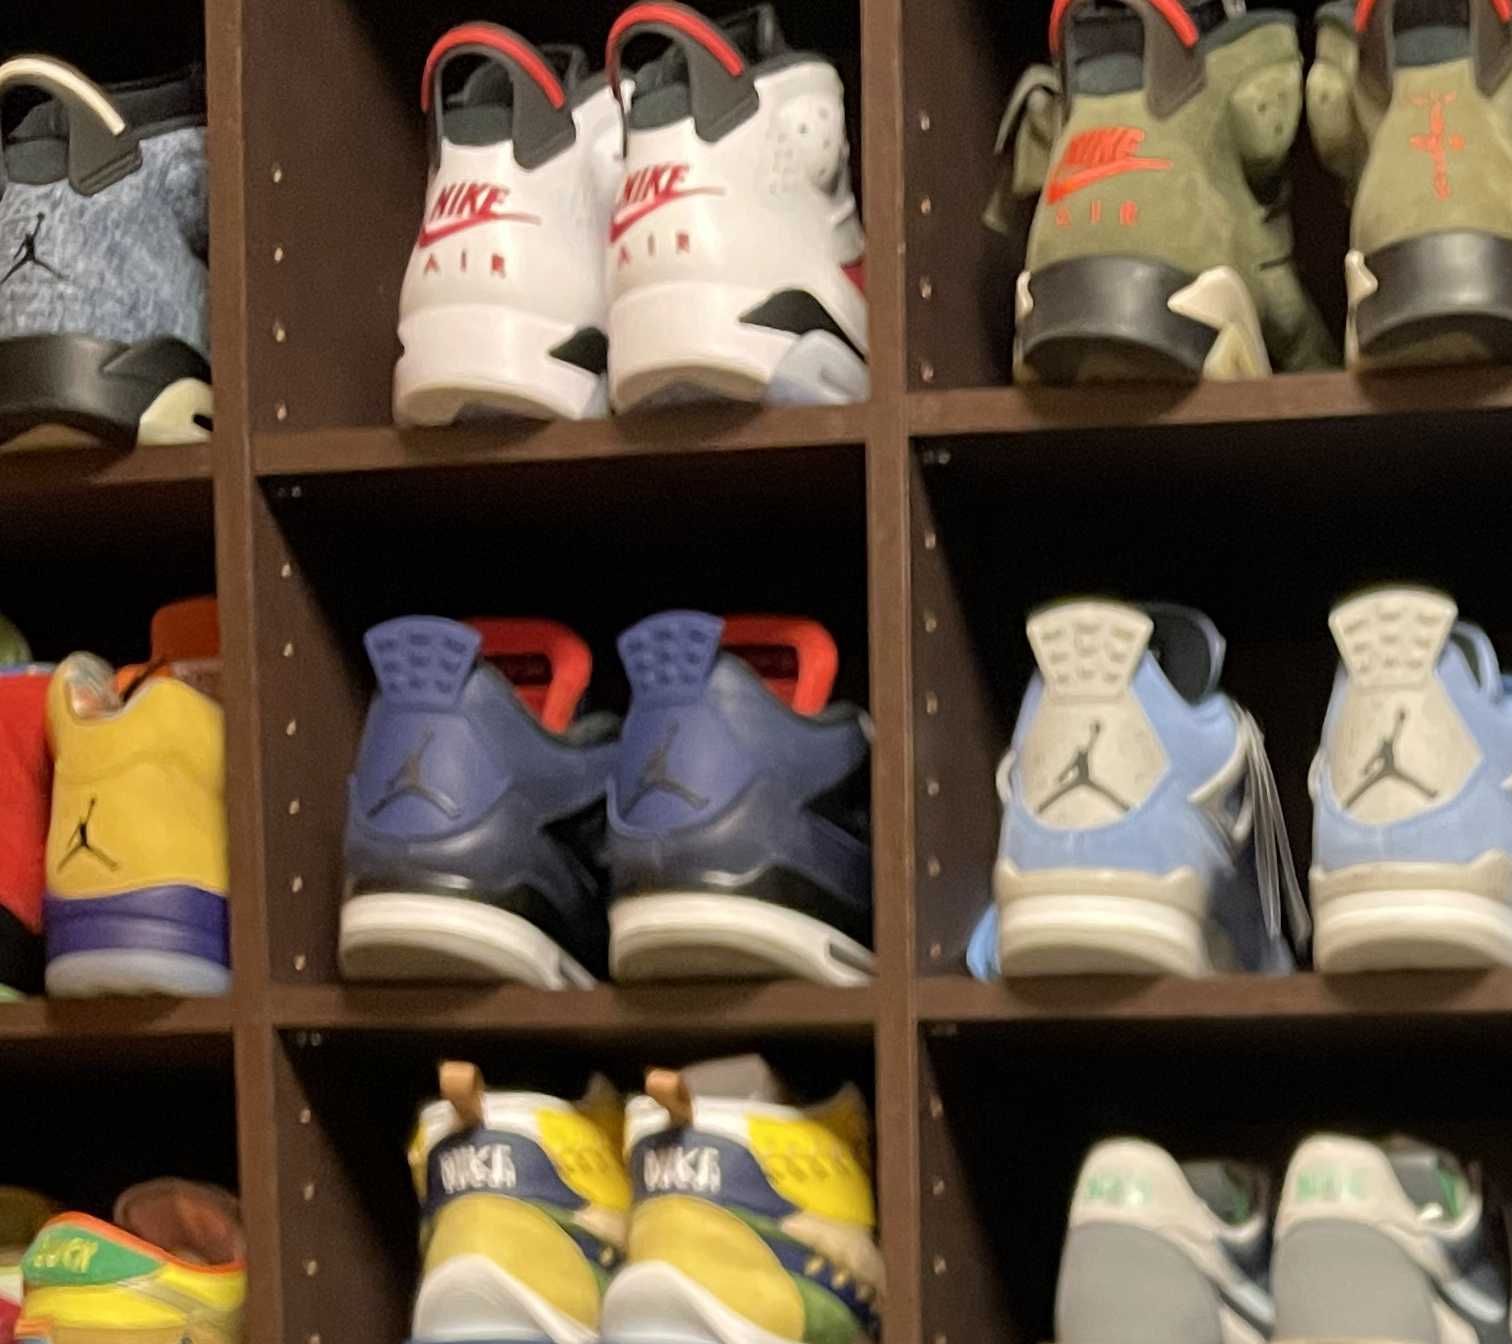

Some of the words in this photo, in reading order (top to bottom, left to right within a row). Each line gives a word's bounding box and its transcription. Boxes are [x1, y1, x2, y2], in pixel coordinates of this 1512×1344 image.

[430, 181, 510, 219] NIKE
[620, 163, 689, 203] NIKE
[424, 249, 506, 279] AIR
[618, 230, 690, 268] AIR
